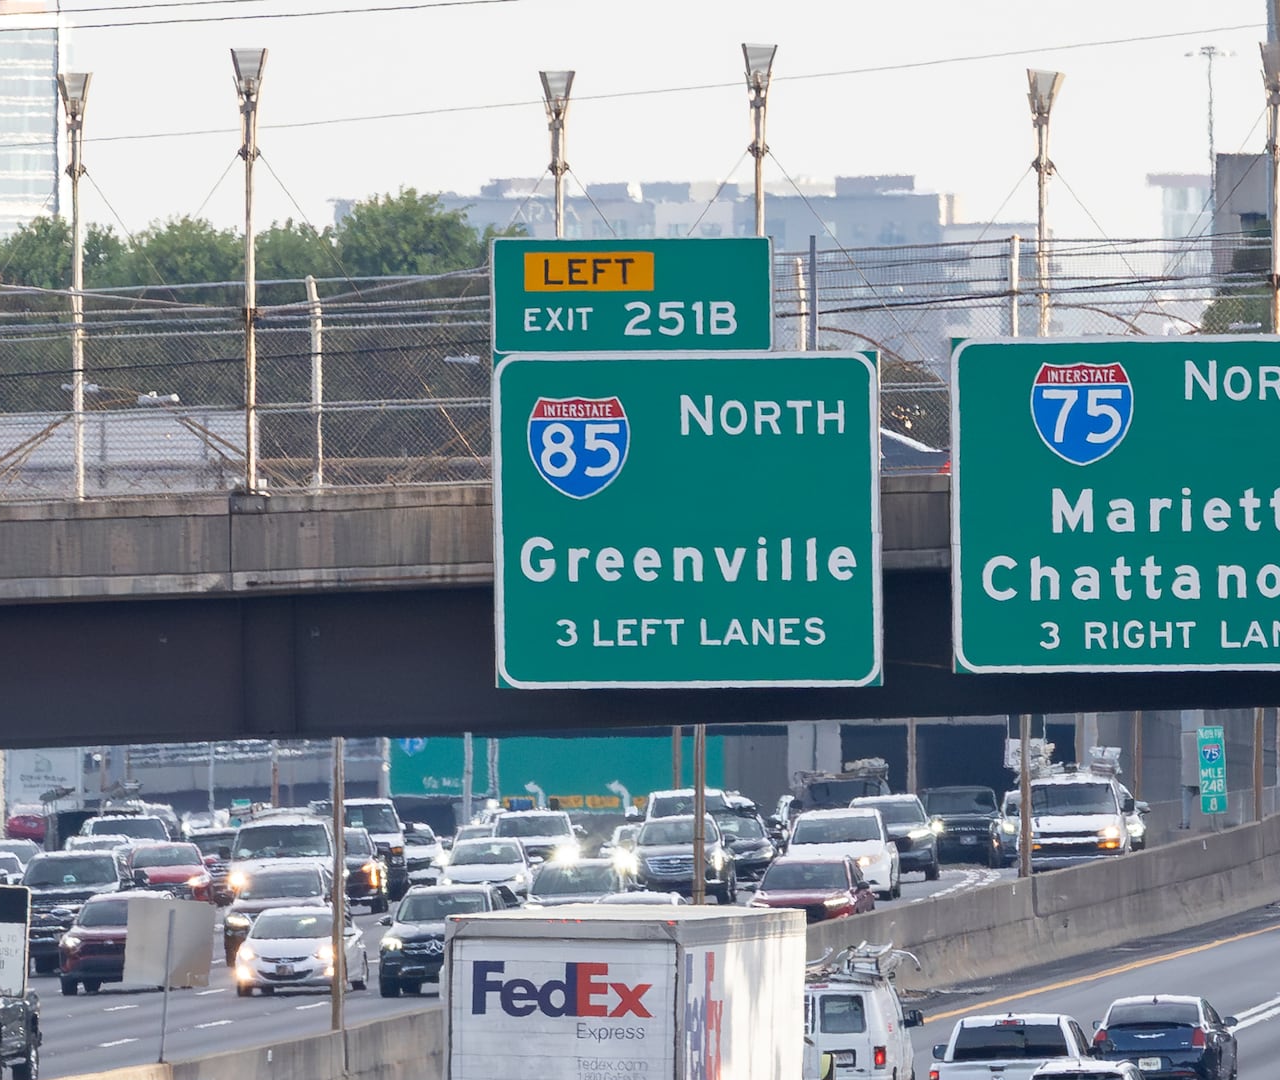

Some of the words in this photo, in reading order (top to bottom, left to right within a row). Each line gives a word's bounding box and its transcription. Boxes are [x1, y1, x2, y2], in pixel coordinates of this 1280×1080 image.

[544, 259, 634, 286] LEFT
[524, 308, 593, 331] EXIT
[624, 302, 737, 335] 251B
[1047, 368, 1122, 382] INTERSTATE
[543, 404, 613, 417] INTERSTATE
[681, 395, 844, 435] NORTH
[1042, 390, 1122, 444] 75
[540, 422, 620, 478] 85
[521, 537, 856, 582] Greenville
[557, 620, 577, 646] 3
[594, 619, 684, 646] LEFT
[701, 618, 825, 645] LANES
[1040, 622, 1060, 649] 3
[1085, 621, 1196, 649] RIGHT
[1201, 767, 1224, 778] MILE
[1202, 780, 1224, 793] 248
[472, 960, 653, 1018] FedEx
[576, 1022, 645, 1043] Express
